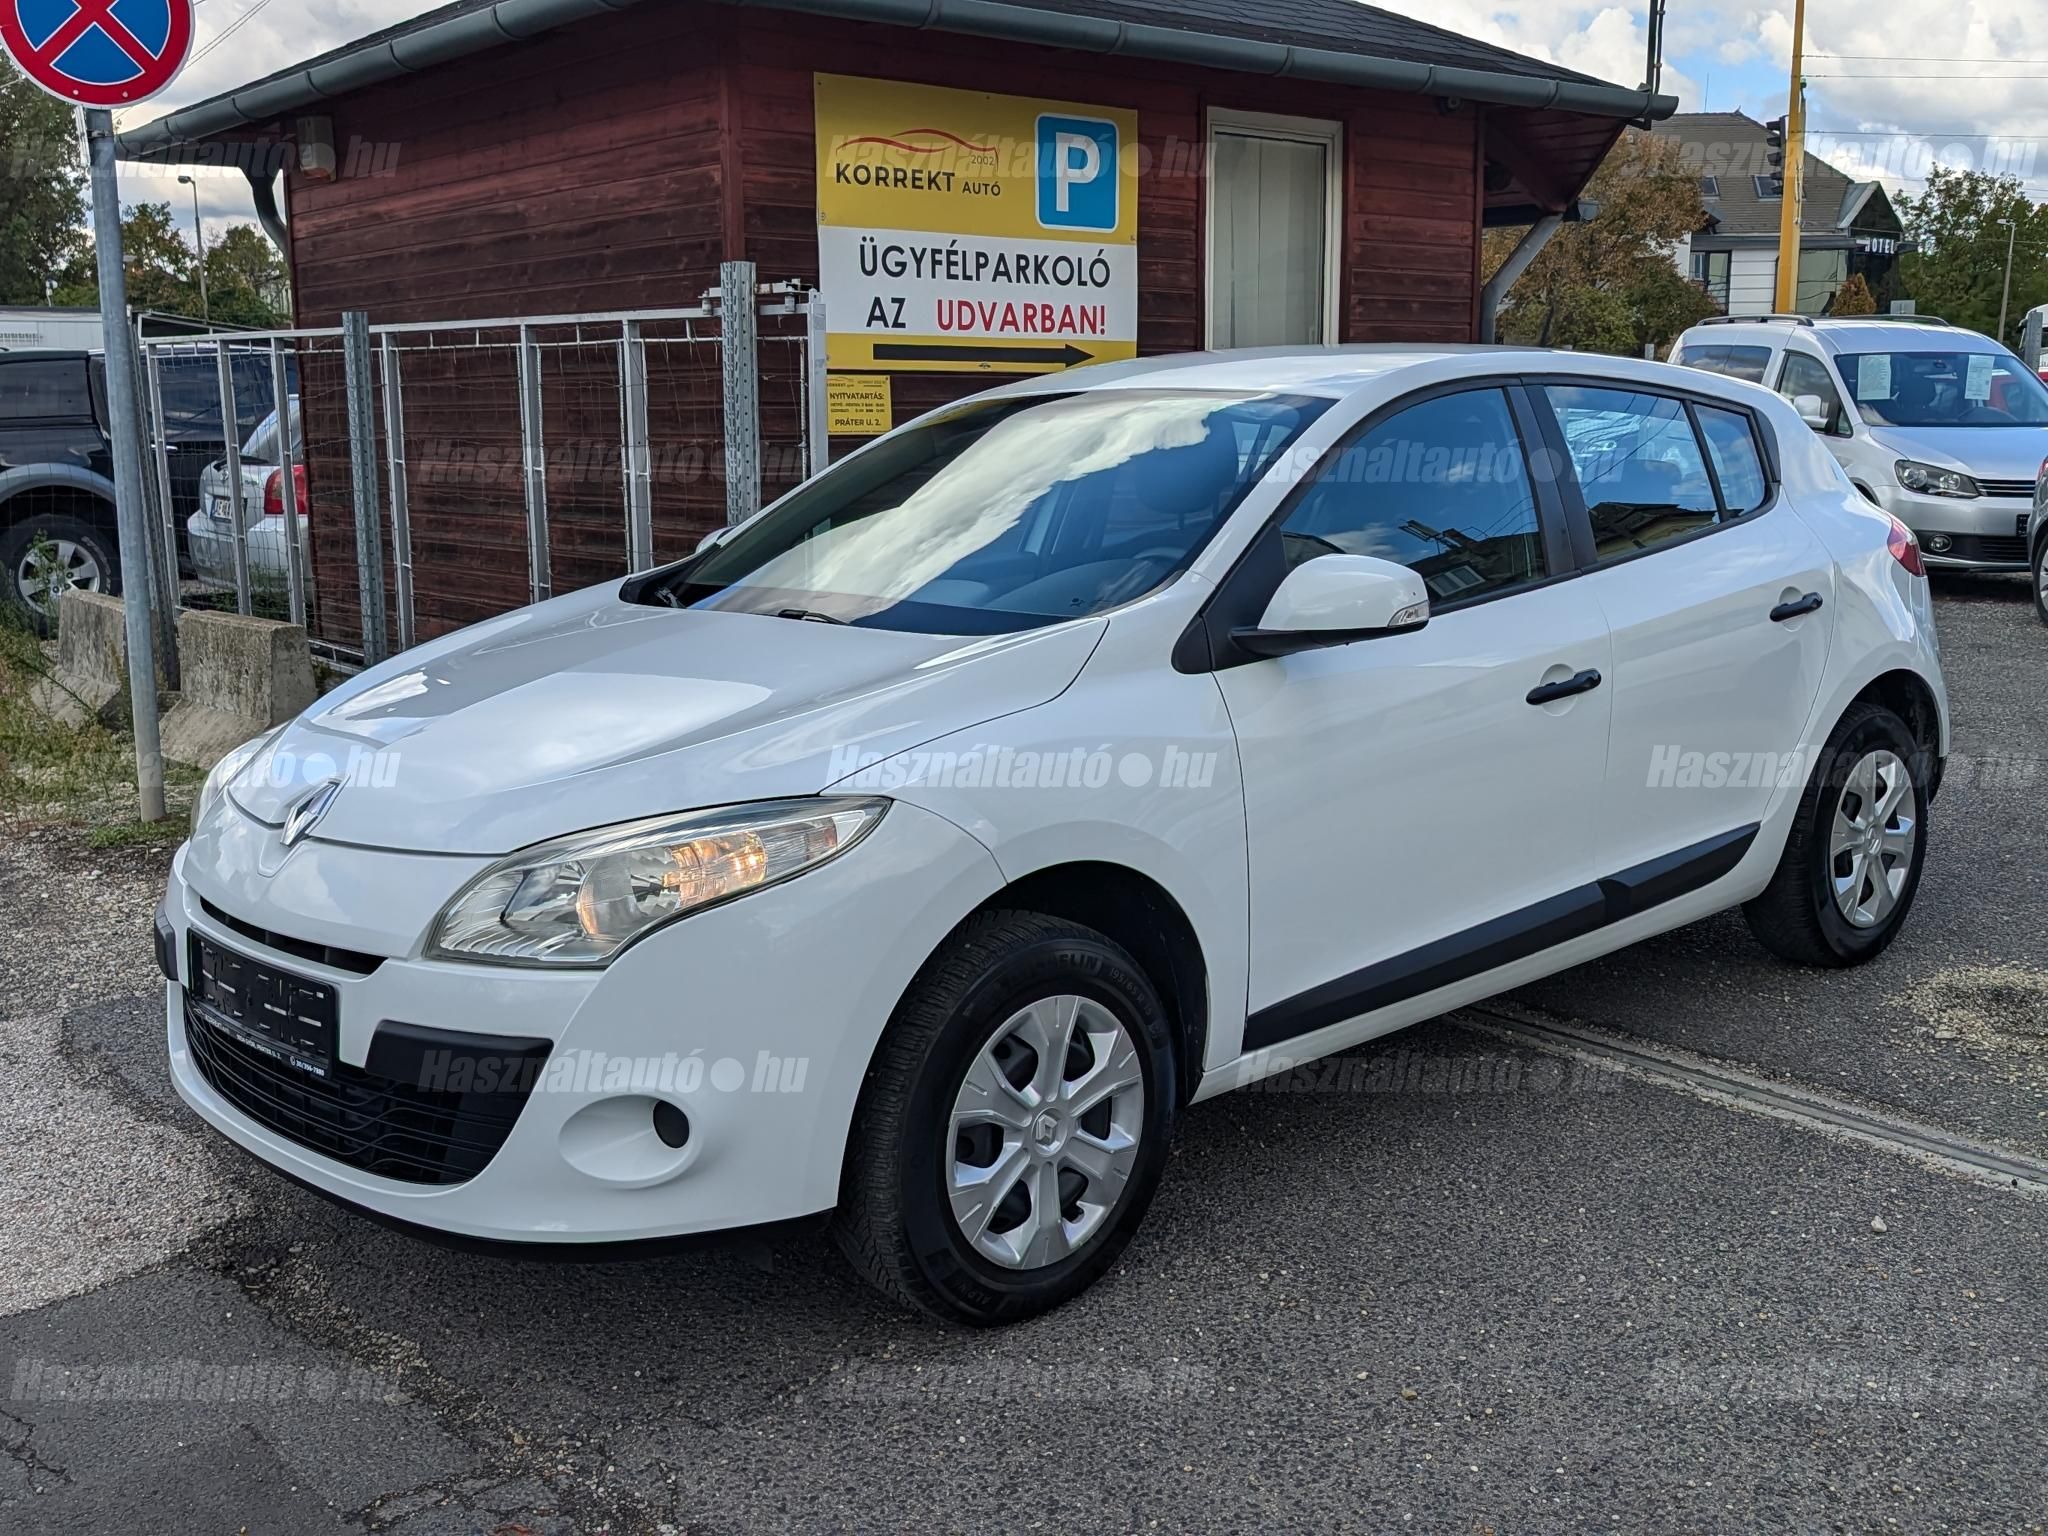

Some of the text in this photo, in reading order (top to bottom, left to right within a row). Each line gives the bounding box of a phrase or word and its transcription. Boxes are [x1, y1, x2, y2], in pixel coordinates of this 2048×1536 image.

[971, 154, 995, 166] 2002
[1056, 131, 1100, 212] P
[835, 163, 1001, 197] KORREKT AUTÓ
[859, 236, 1111, 288] ÜGYFÉLPARKOLÓ
[866, 296, 1106, 335] AZ UDVARBAN!
[830, 391, 885, 400] NYITVATARTÁS:
[835, 417, 864, 426] PRÁTER
[866, 418, 873, 426] U.
